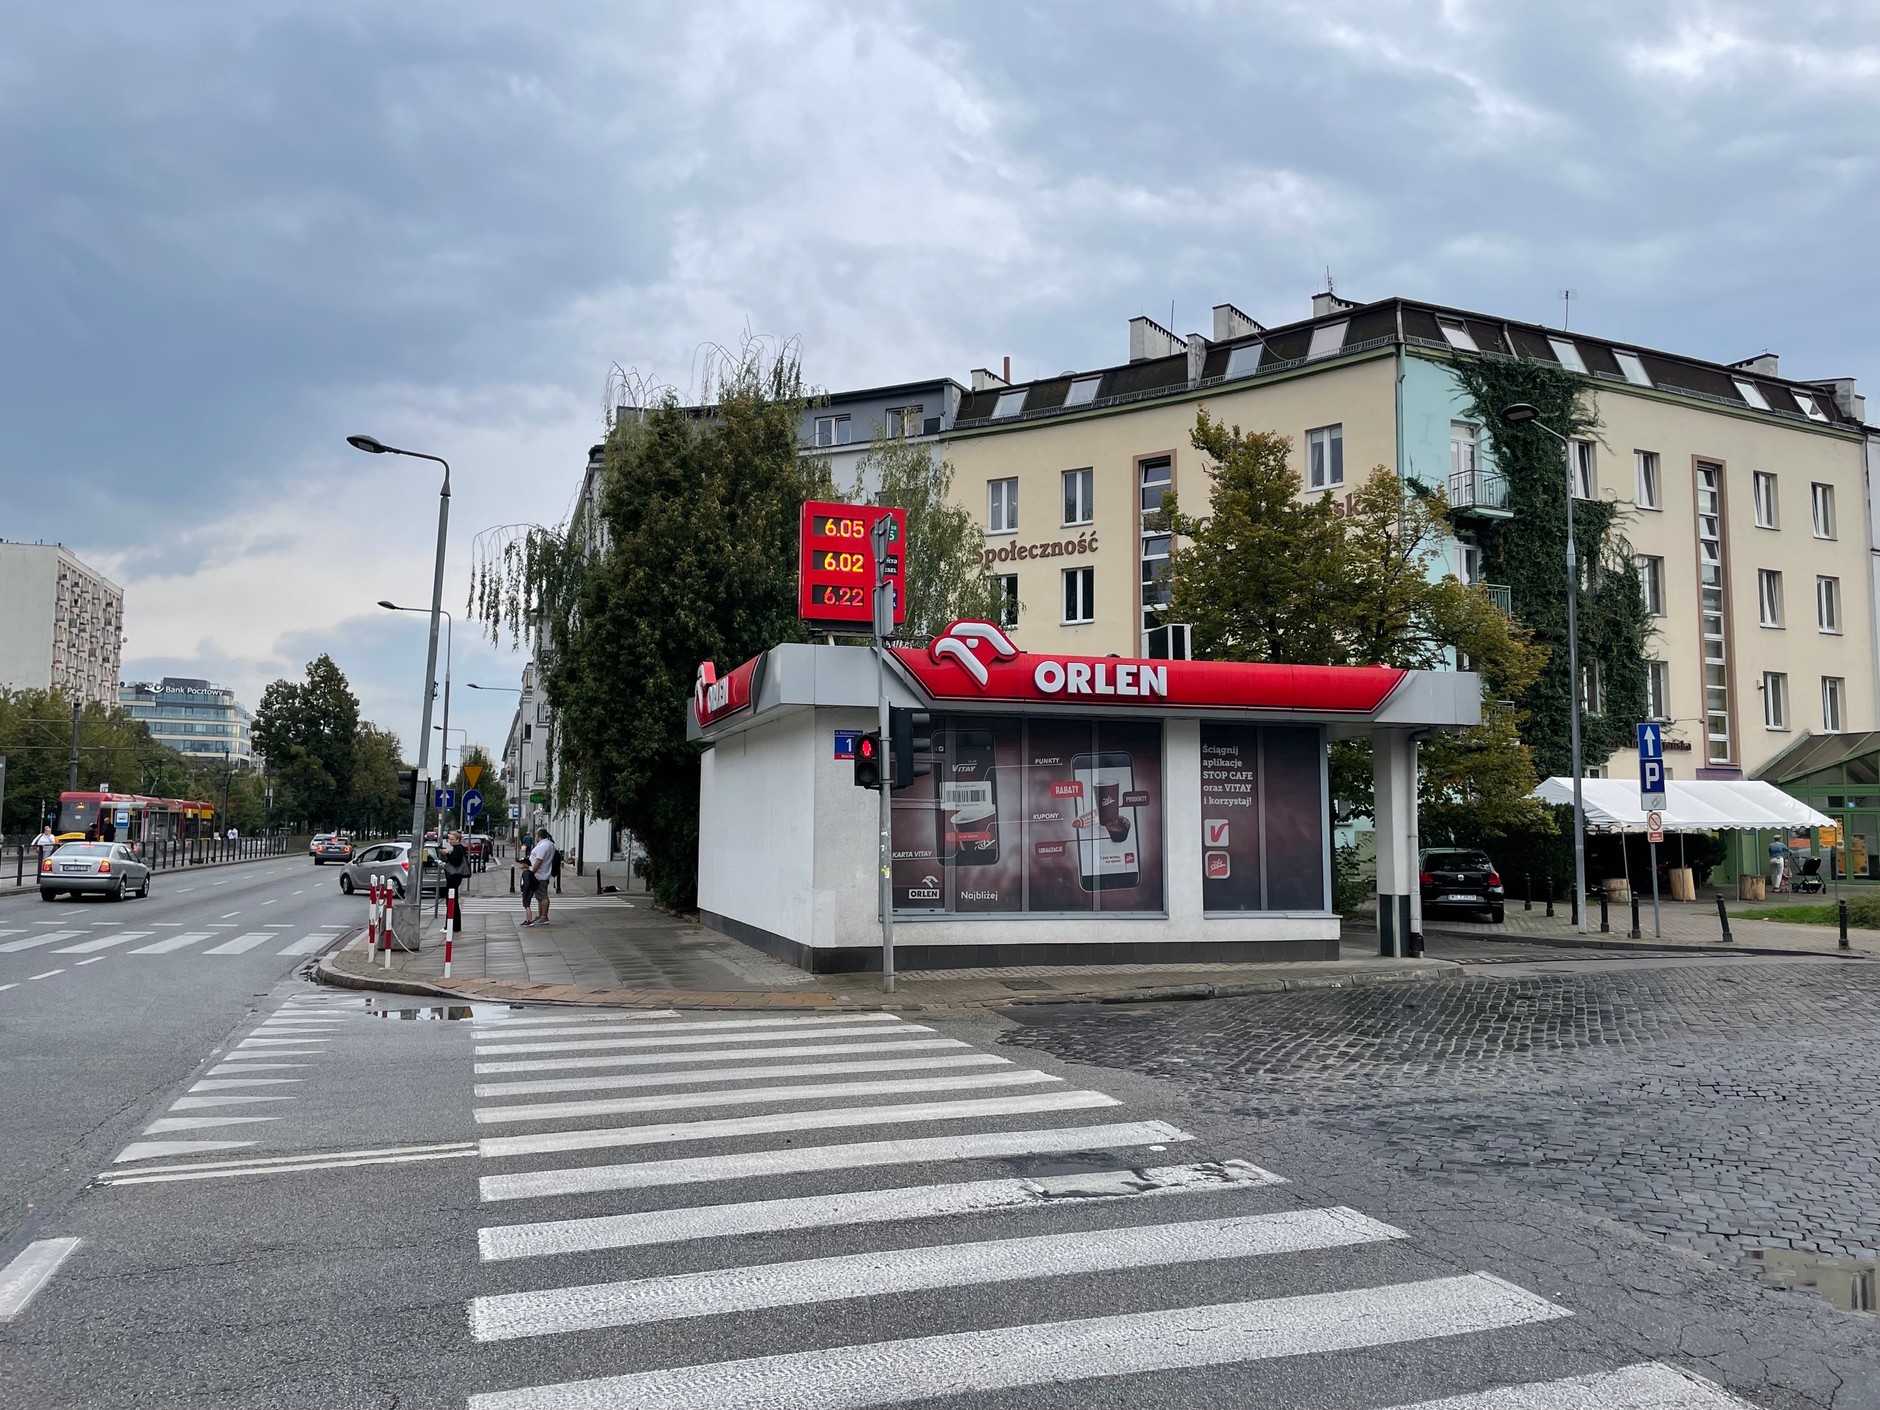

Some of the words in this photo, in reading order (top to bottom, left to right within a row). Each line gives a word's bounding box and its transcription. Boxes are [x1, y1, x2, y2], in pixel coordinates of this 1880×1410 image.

[825, 519, 864, 538] 6.05
[824, 553, 863, 572] 6.02
[824, 587, 863, 606] 6.22
[1034, 660, 1167, 697] ORLEN
[165, 686, 185, 694] Bank
[187, 686, 223, 697] Pocztowy
[1202, 743, 1239, 755] Ściągnij
[952, 763, 977, 772] VITAY
[1202, 759, 1243, 768] aplikacje
[1202, 771, 1228, 779] STOP
[1229, 771, 1253, 780] CAFE
[1645, 762, 1660, 789] P
[1055, 785, 1079, 795] RABATY
[1224, 784, 1252, 792] VITAY
[1203, 797, 1207, 805] i
[1209, 797, 1252, 807] korzystaj!
[914, 850, 933, 858] VITAY
[910, 889, 939, 899] ORLEN
[960, 891, 998, 901] Najbliżej
